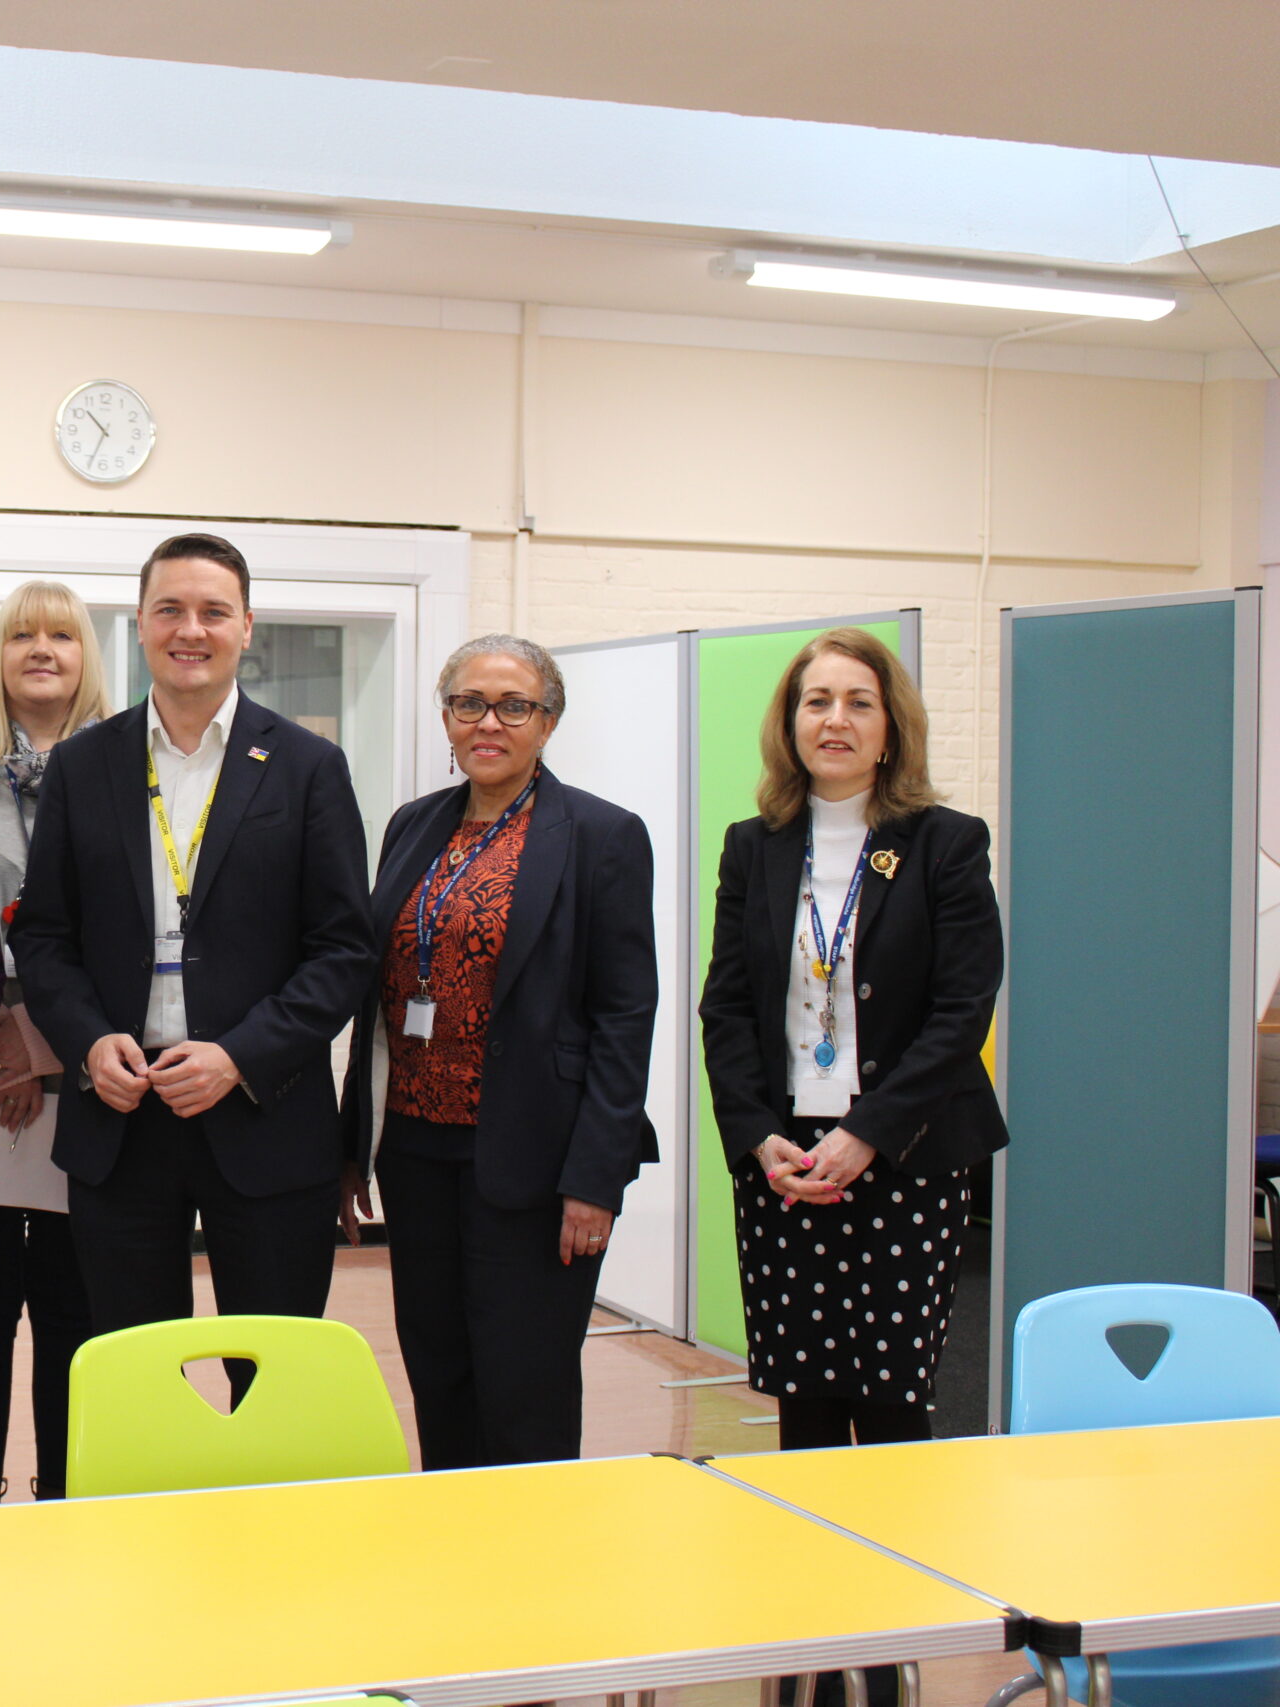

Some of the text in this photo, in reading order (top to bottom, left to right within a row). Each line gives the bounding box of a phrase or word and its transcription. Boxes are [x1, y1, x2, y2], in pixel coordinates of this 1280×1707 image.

[84, 396, 94, 407] 11
[99, 392, 113, 405] 12
[72, 407, 85, 420] 10
[128, 410, 138, 423] 2
[67, 424, 78, 436] 9
[131, 428, 141, 441] 3
[71, 441, 82, 454] 8
[126, 445, 136, 455] 4
[98, 459, 108, 471] 6
[115, 456, 125, 468] 5
[157, 810, 169, 836] VISITOR
[168, 848, 180, 876] VISITOR
[843, 869, 863, 916] Redbridge Institute
